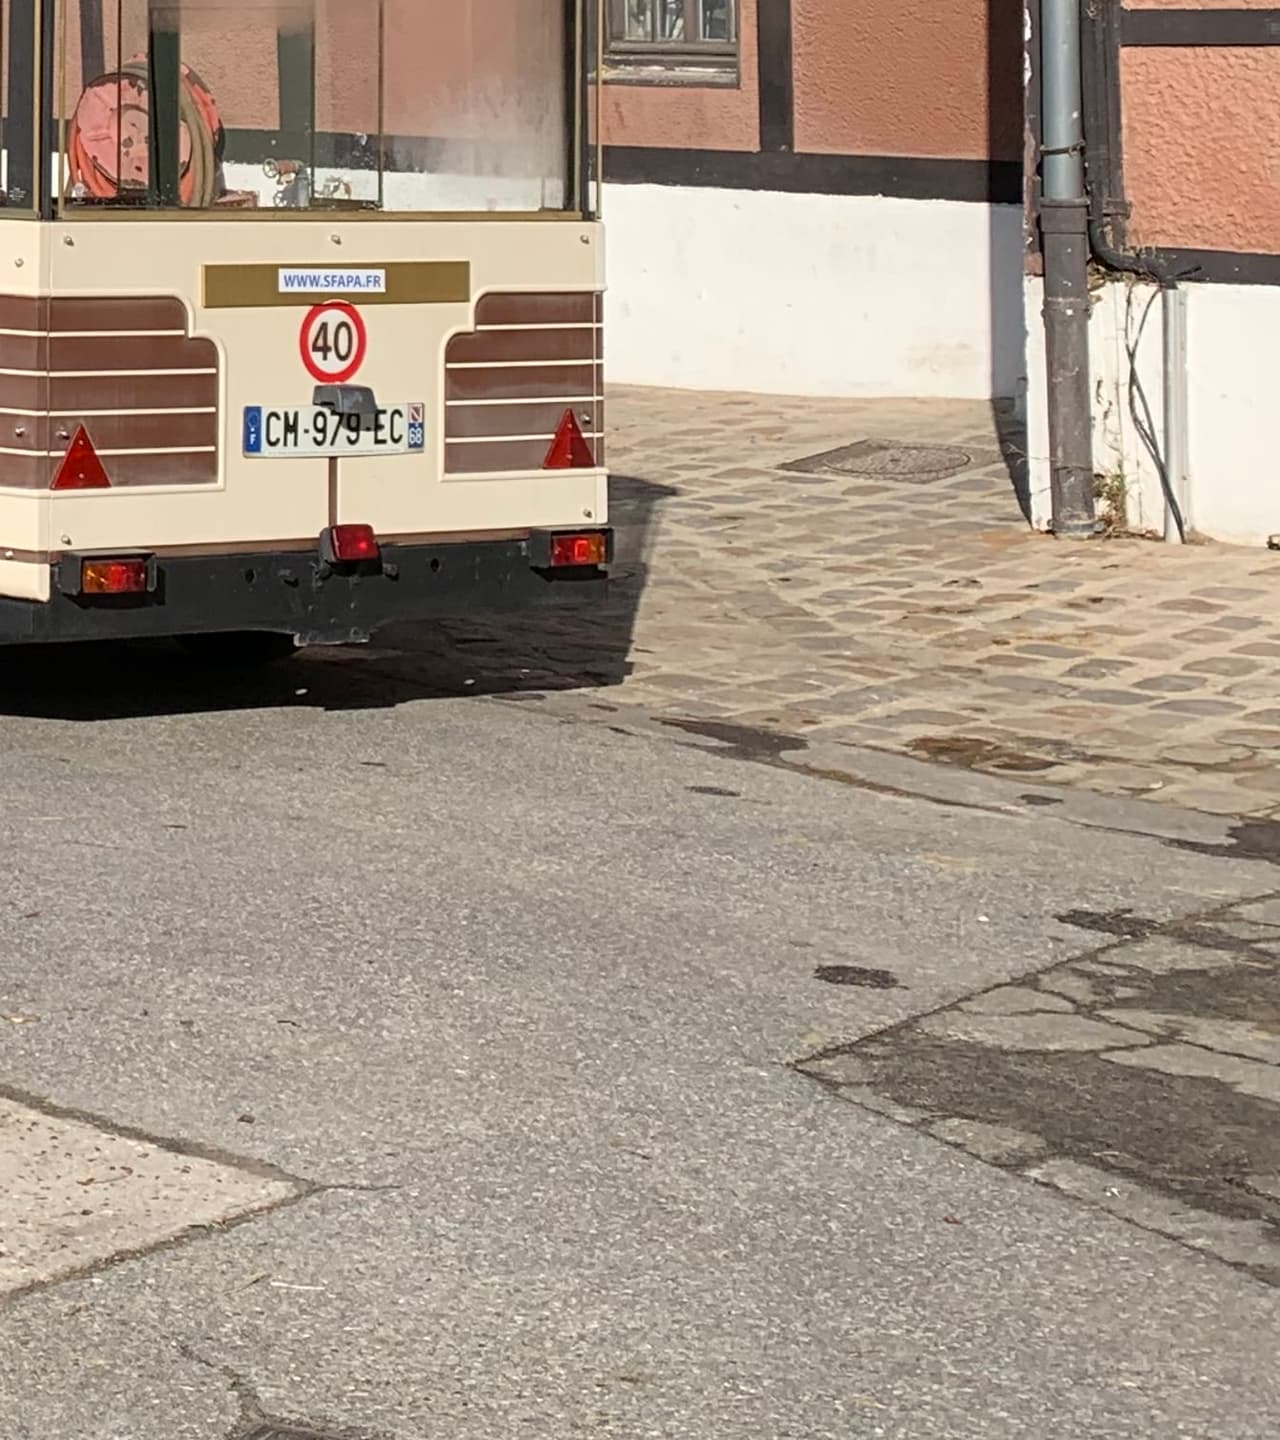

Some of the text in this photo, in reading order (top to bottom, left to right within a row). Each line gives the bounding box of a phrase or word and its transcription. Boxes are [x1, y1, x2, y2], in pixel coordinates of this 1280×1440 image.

[283, 274, 382, 288] WWW.SFAPA.FR
[311, 320, 353, 362] 40
[265, 409, 404, 447] CM-979-EC
[409, 427, 423, 445] 68
[249, 434, 257, 445] F
